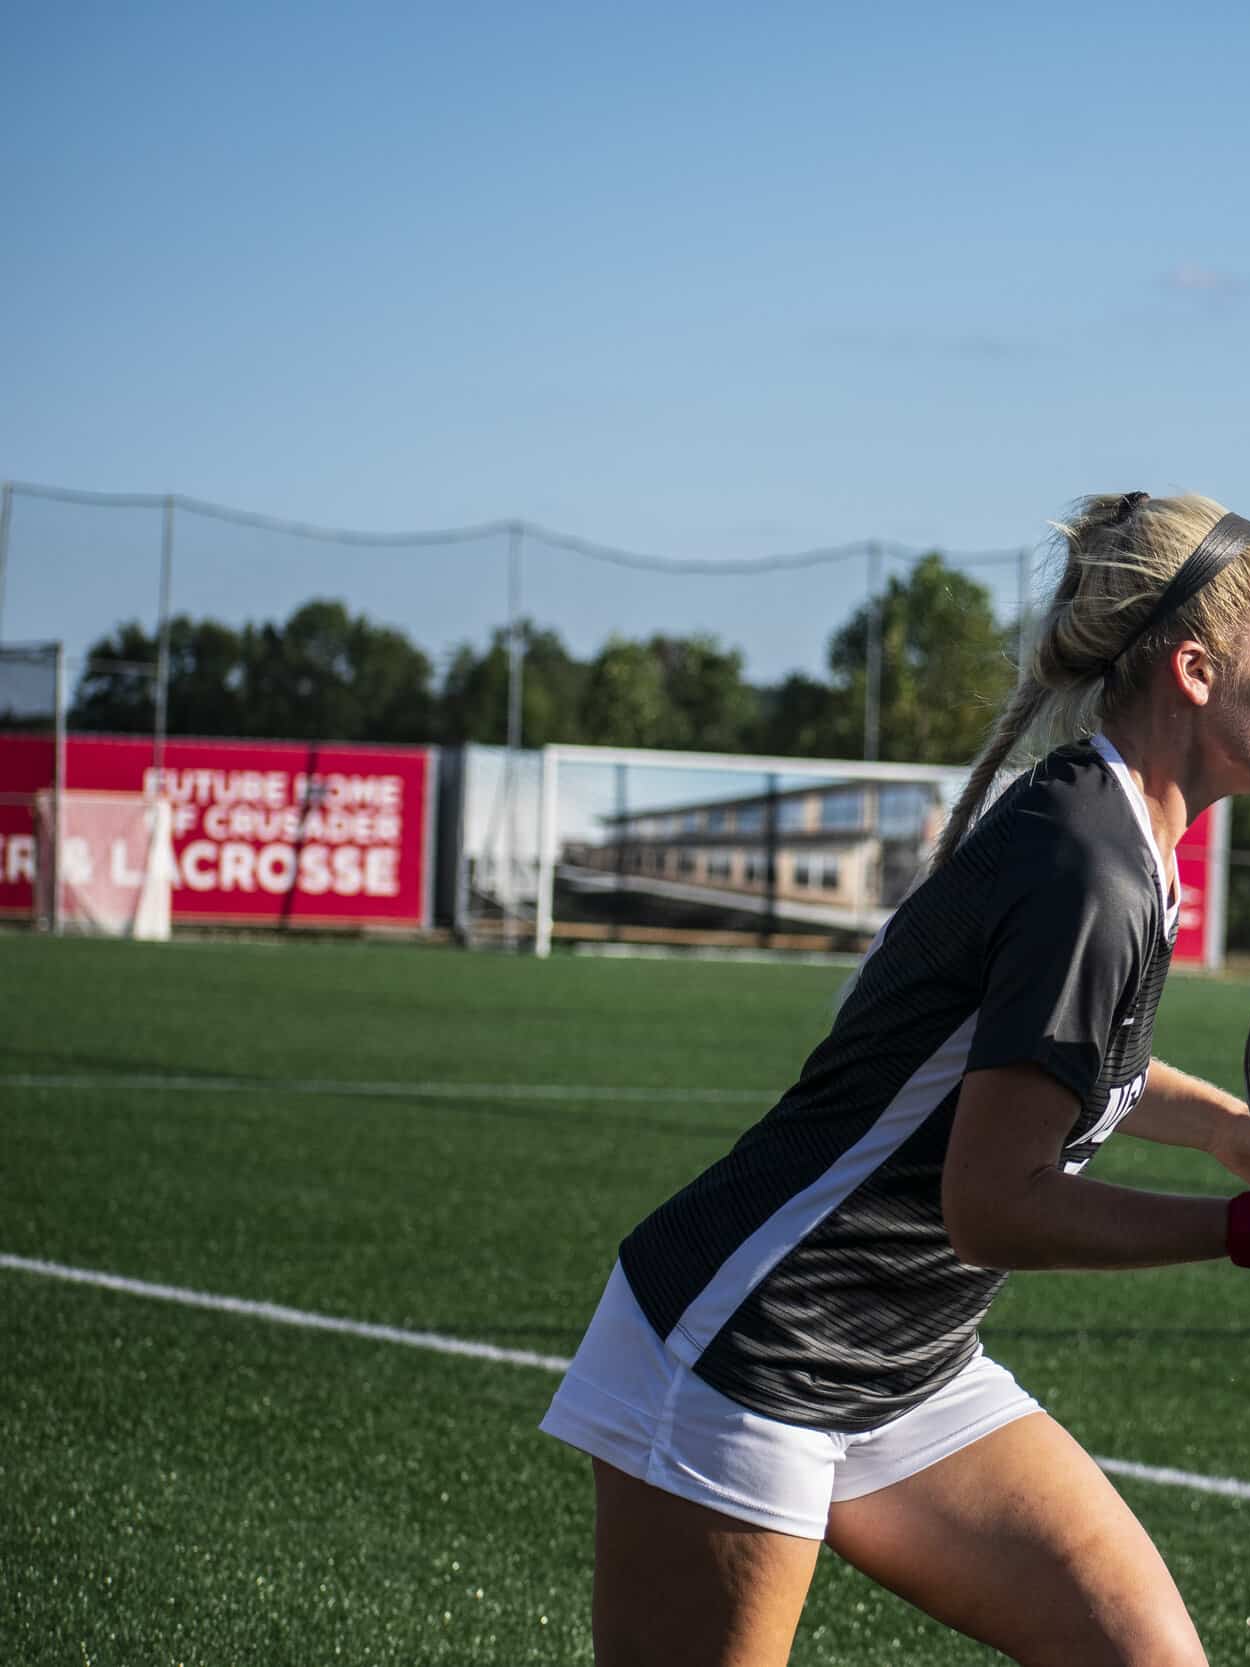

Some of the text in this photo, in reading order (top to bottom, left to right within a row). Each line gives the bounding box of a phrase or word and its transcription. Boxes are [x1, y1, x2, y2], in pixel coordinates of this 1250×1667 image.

[143, 768, 402, 808] FUTURE HOME
[203, 805, 401, 844] CRUSADER
